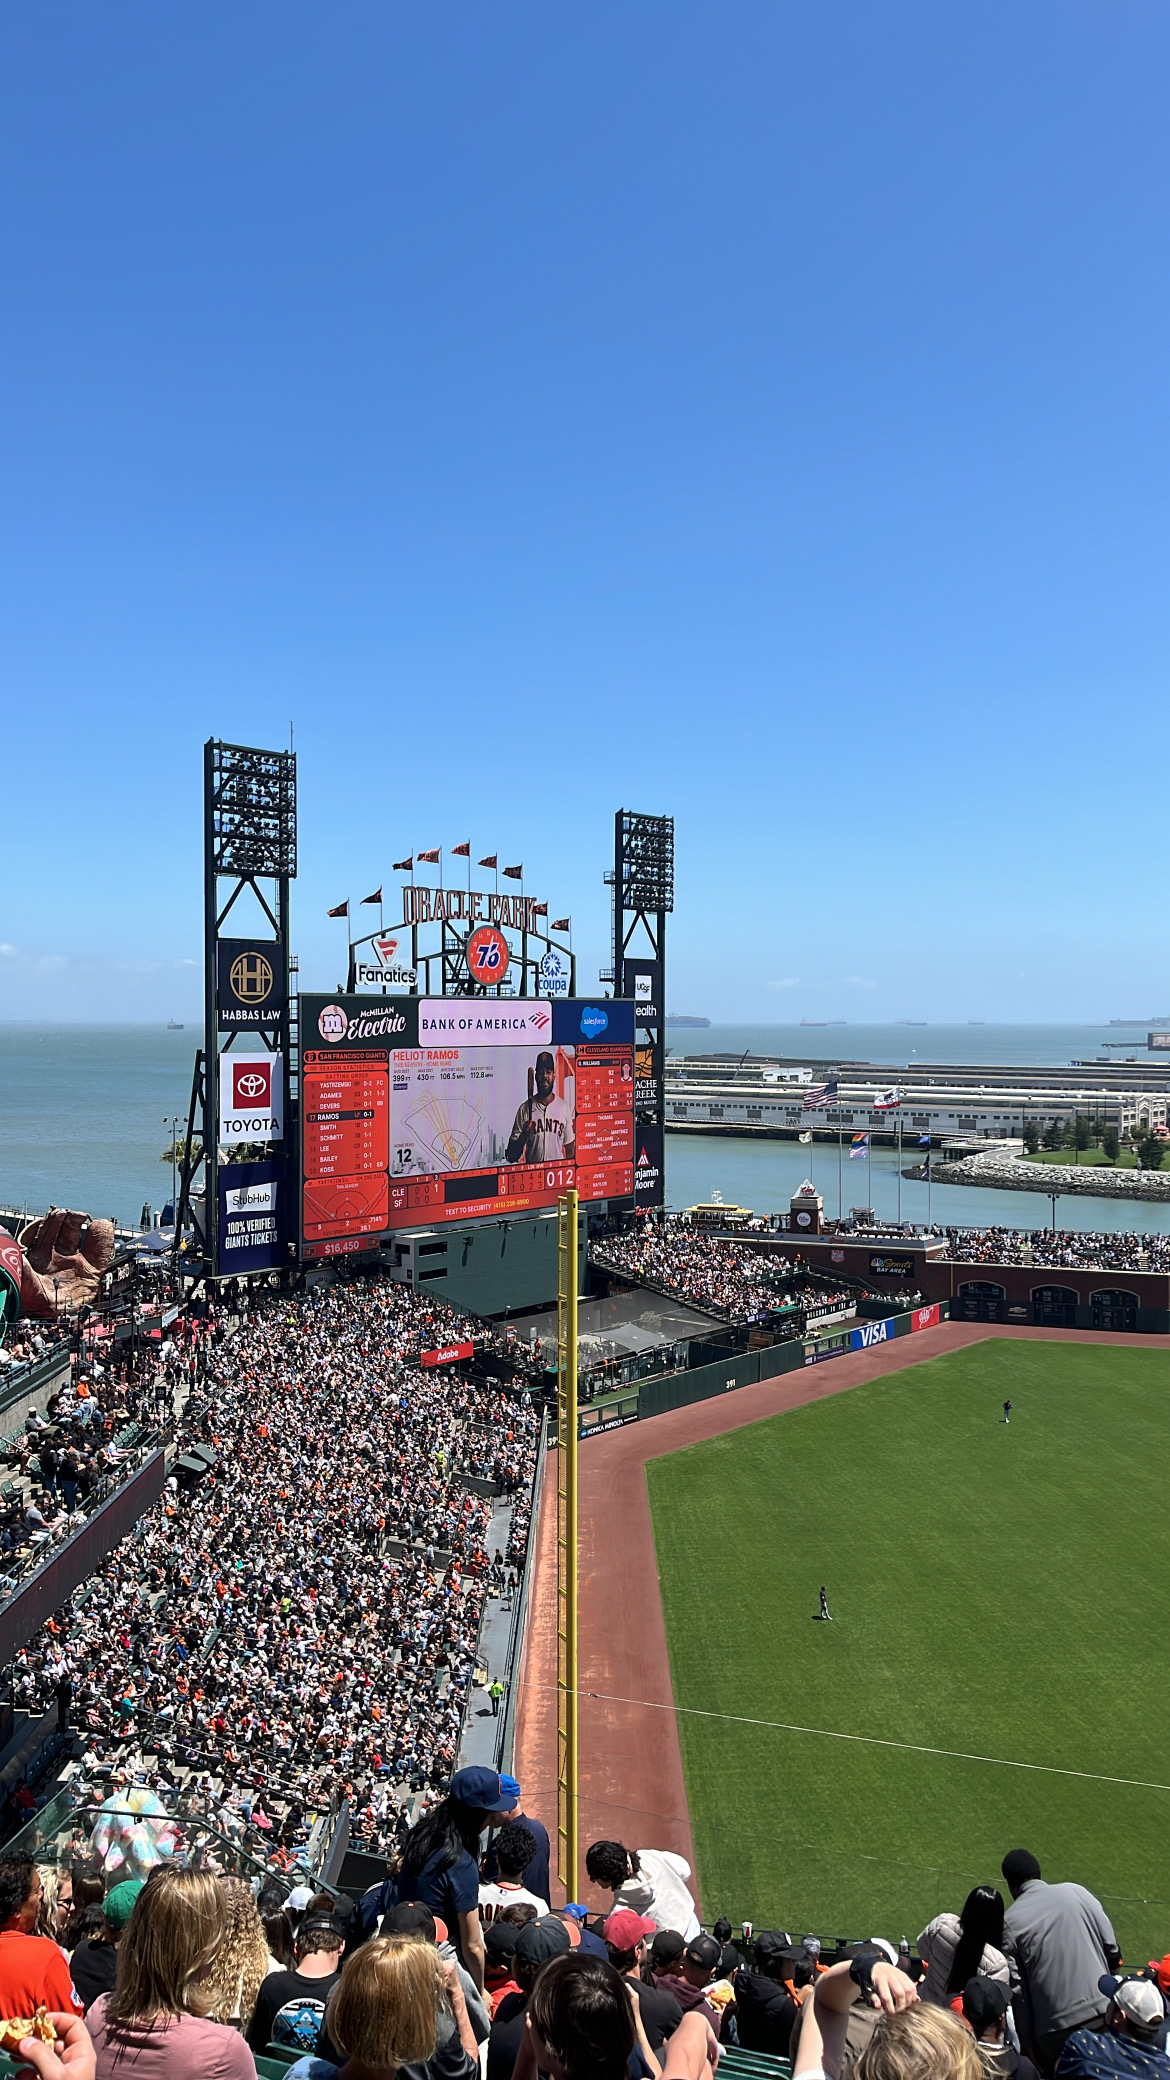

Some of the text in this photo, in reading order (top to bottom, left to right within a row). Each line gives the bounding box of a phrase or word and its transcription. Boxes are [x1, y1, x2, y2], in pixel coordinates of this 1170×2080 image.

[403, 886, 538, 934] ORACLE PARK
[477, 942, 500, 969] 76
[358, 965, 417, 983] Fanatics
[539, 979, 567, 992] coupa
[222, 1009, 281, 1020] HABBAS LAW
[360, 1006, 395, 1018] McMILLAN
[635, 1004, 657, 1016] ealth
[347, 1013, 407, 1040] Electric
[422, 1019, 526, 1030] BANK OF AMERICA
[583, 1018, 606, 1027] salesforce
[320, 1053, 332, 1061] SAN
[393, 1050, 459, 1061] HELIOT RAMOS
[635, 1079, 658, 1089] ACHE
[635, 1089, 657, 1099] REEK
[320, 1102, 340, 1110] DEVERS
[317, 1113, 340, 1121] RAMOS
[223, 1118, 280, 1133] TOYOTA
[537, 1118, 565, 1138] ANTS
[320, 1133, 344, 1141] SCHMITT
[396, 1148, 412, 1163] 12
[634, 1167, 659, 1181] enjamin
[233, 1192, 271, 1206] StubHub
[391, 1188, 405, 1197] CLE
[394, 1199, 403, 1208] SF
[500, 1185, 506, 1194] 0
[445, 1208, 459, 1216] TEXT
[467, 1203, 492, 1213] SECURITY
[227, 1217, 276, 1235] 100% VERIFIED
[225, 1230, 278, 1250] GIANTS TICKETS
[324, 1240, 360, 1254] $16,450
[883, 1258, 914, 1269] Sports
[859, 1322, 888, 1347] VISA
[436, 1349, 460, 1362] Adobe
[725, 1378, 736, 1390] 391
